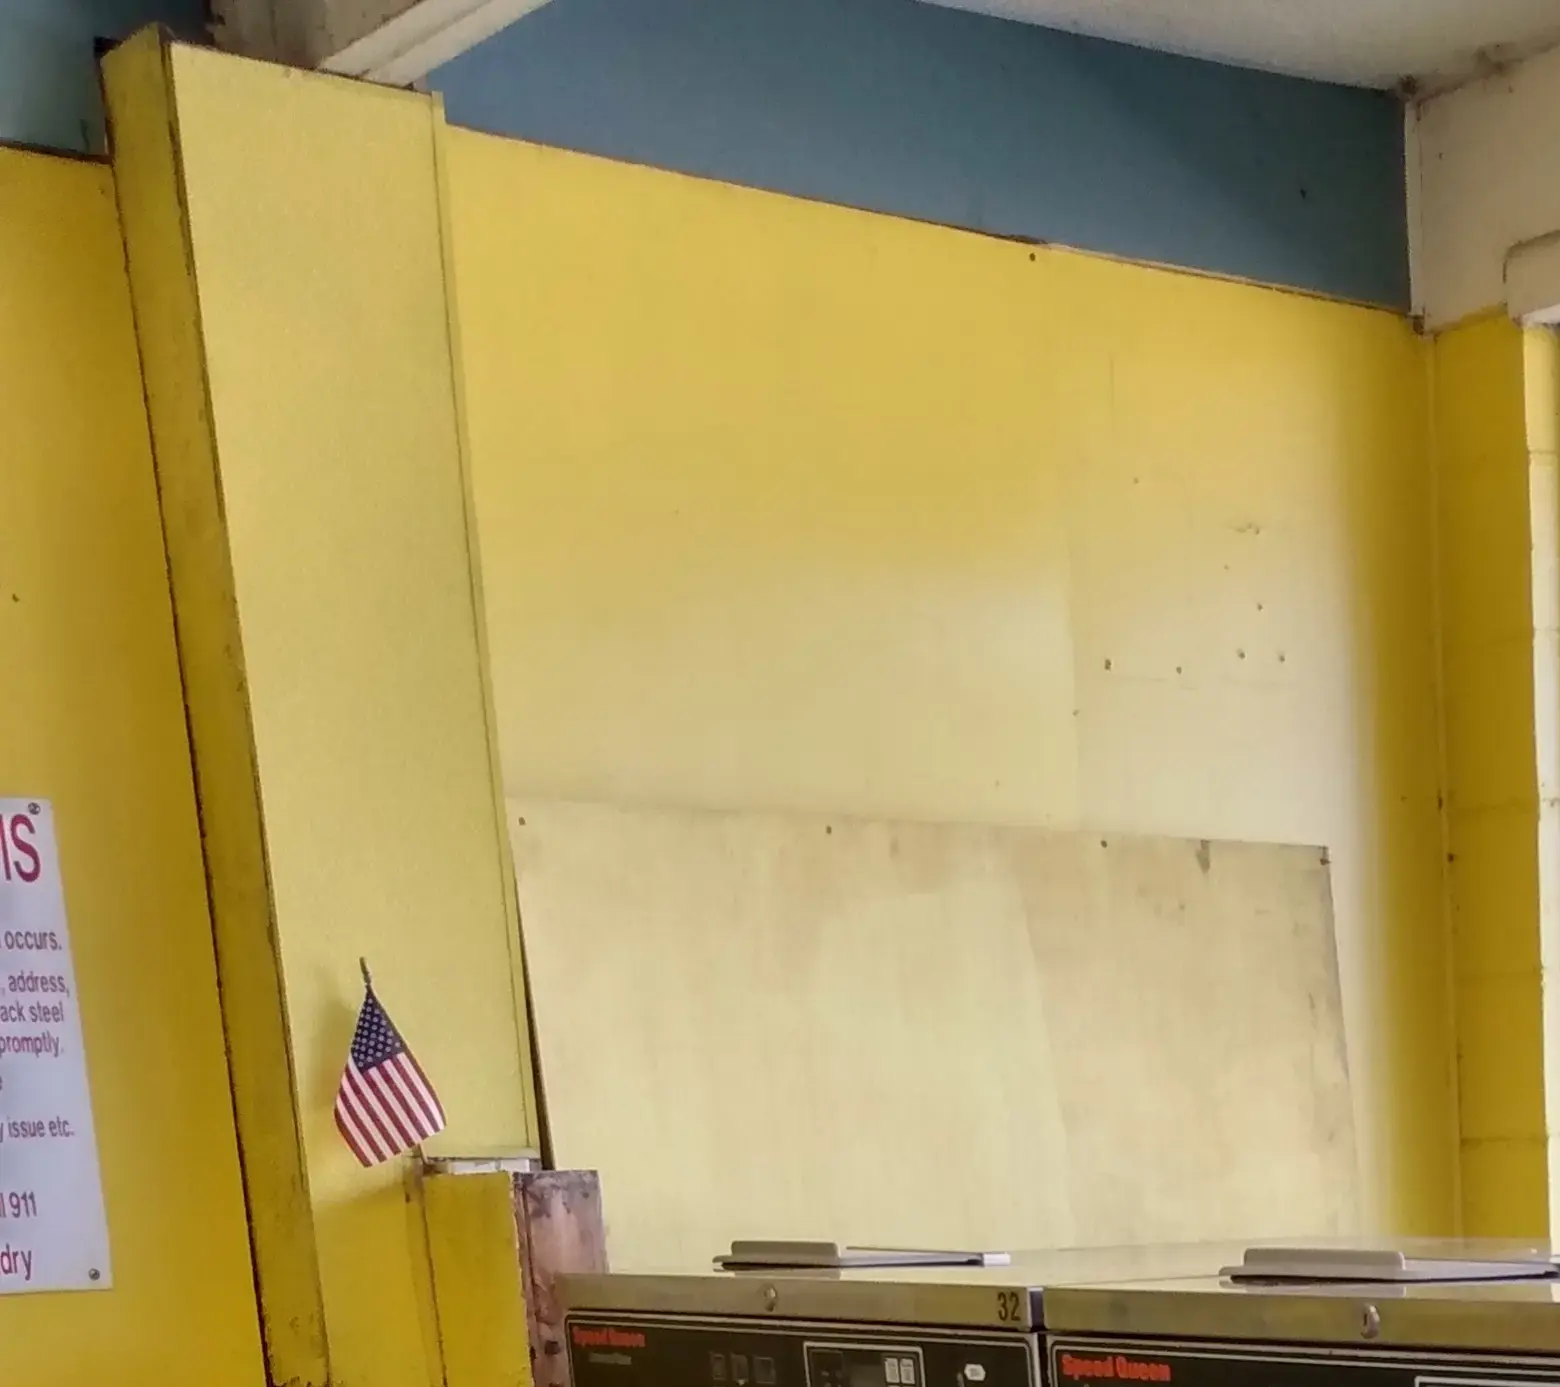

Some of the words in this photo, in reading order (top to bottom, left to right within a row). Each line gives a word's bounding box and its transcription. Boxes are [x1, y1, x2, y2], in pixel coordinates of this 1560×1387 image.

[4, 931, 62, 951] occurs.
[8, 970, 70, 998] address,
[28, 1001, 64, 1022] steel
[7, 1116, 45, 1138] issue
[49, 1116, 75, 1137] etc.
[9, 1191, 37, 1218] 911
[998, 1292, 1021, 1321] 32
[1062, 1354, 1114, 1380] Speed
[1116, 1355, 1171, 1382] Queen
